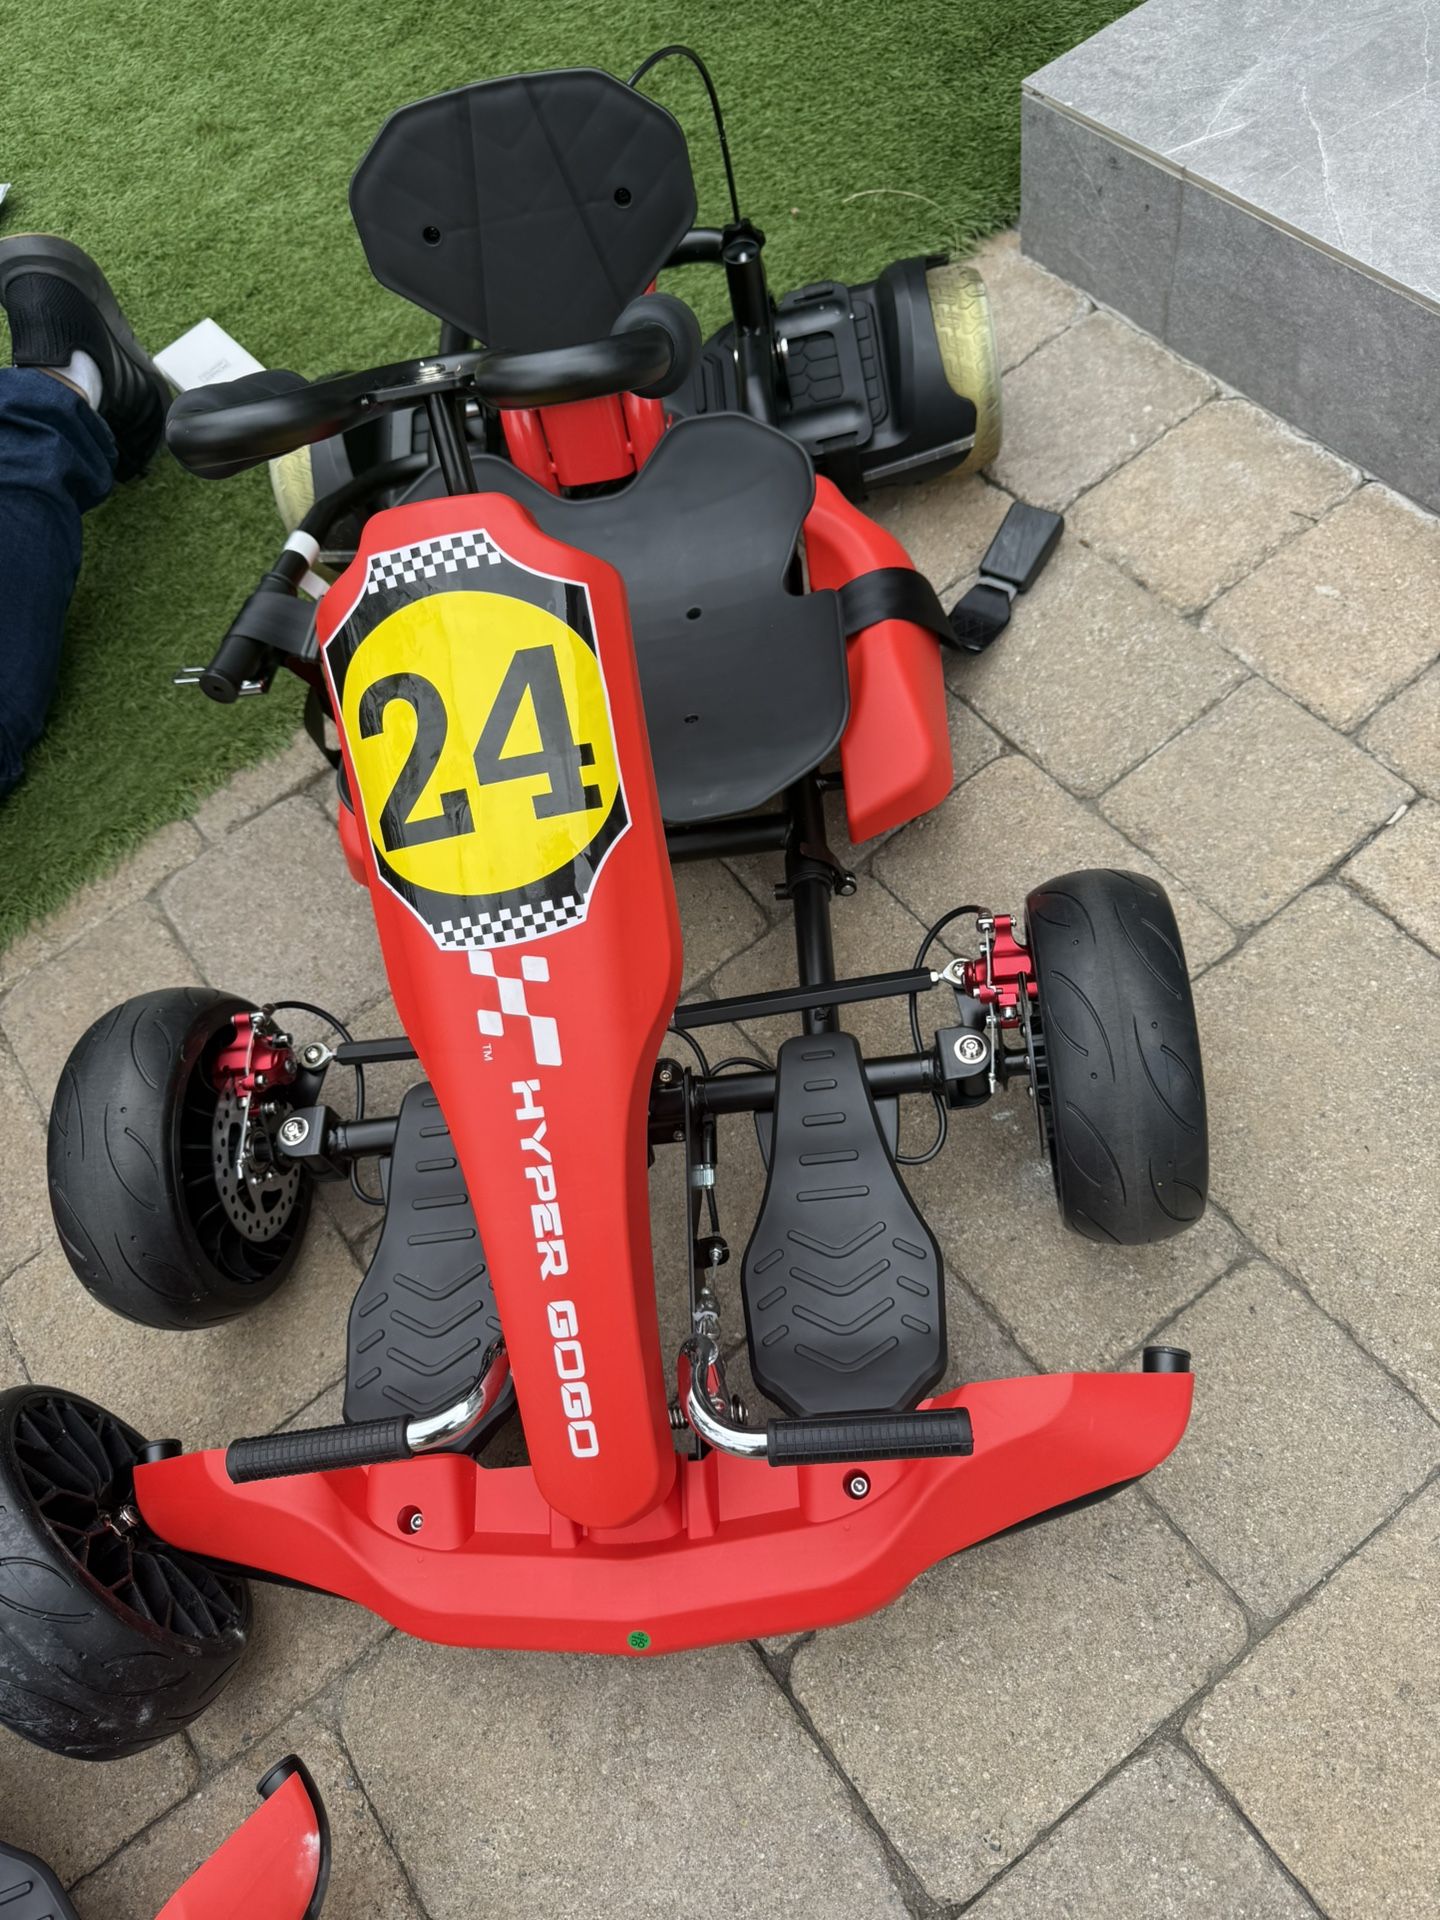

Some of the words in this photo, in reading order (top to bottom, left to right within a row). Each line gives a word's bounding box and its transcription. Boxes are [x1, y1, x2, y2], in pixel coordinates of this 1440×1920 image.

[359, 644, 603, 853] 24
[482, 1042, 494, 1062] TM
[511, 1078, 569, 1281] HYPER
[546, 1299, 600, 1459] GOGO
